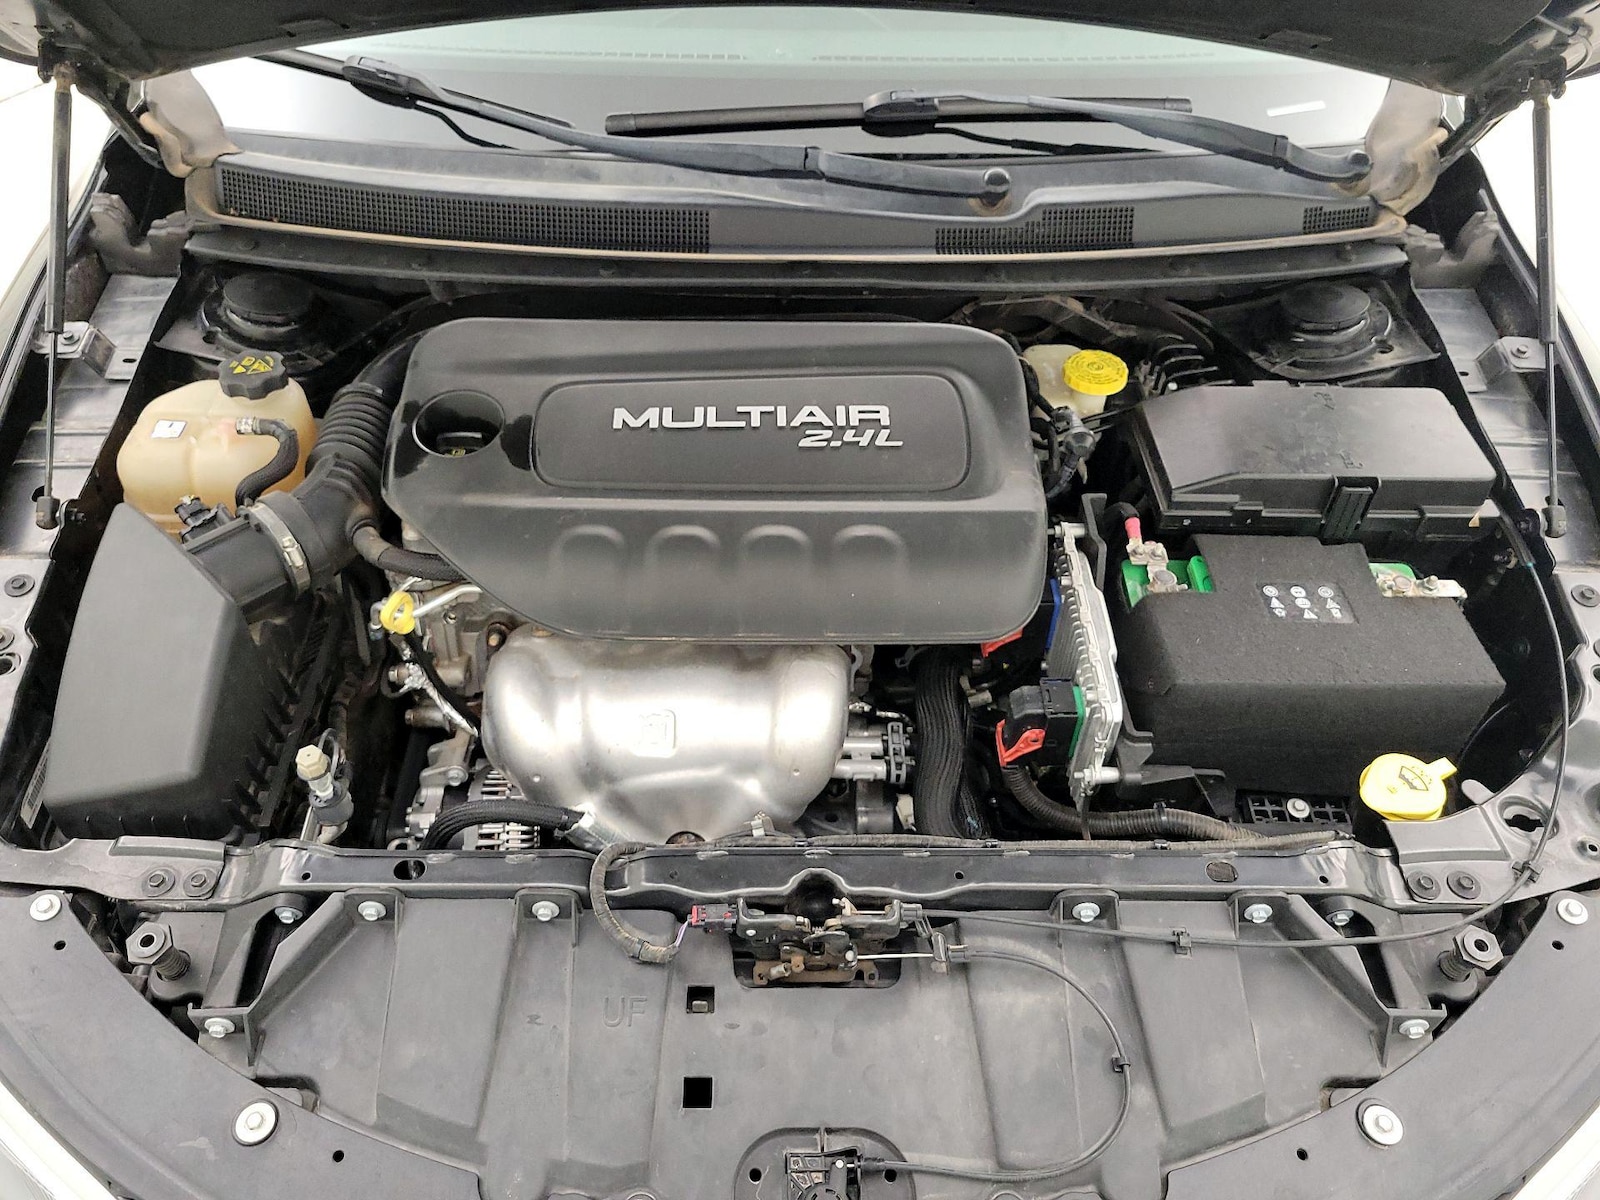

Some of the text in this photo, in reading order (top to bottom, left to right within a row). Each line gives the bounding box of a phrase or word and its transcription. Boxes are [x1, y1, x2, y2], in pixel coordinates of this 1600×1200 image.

[612, 405, 891, 429] MULTIAIR
[798, 429, 904, 447] 2.4L
[602, 995, 648, 1028] UF
